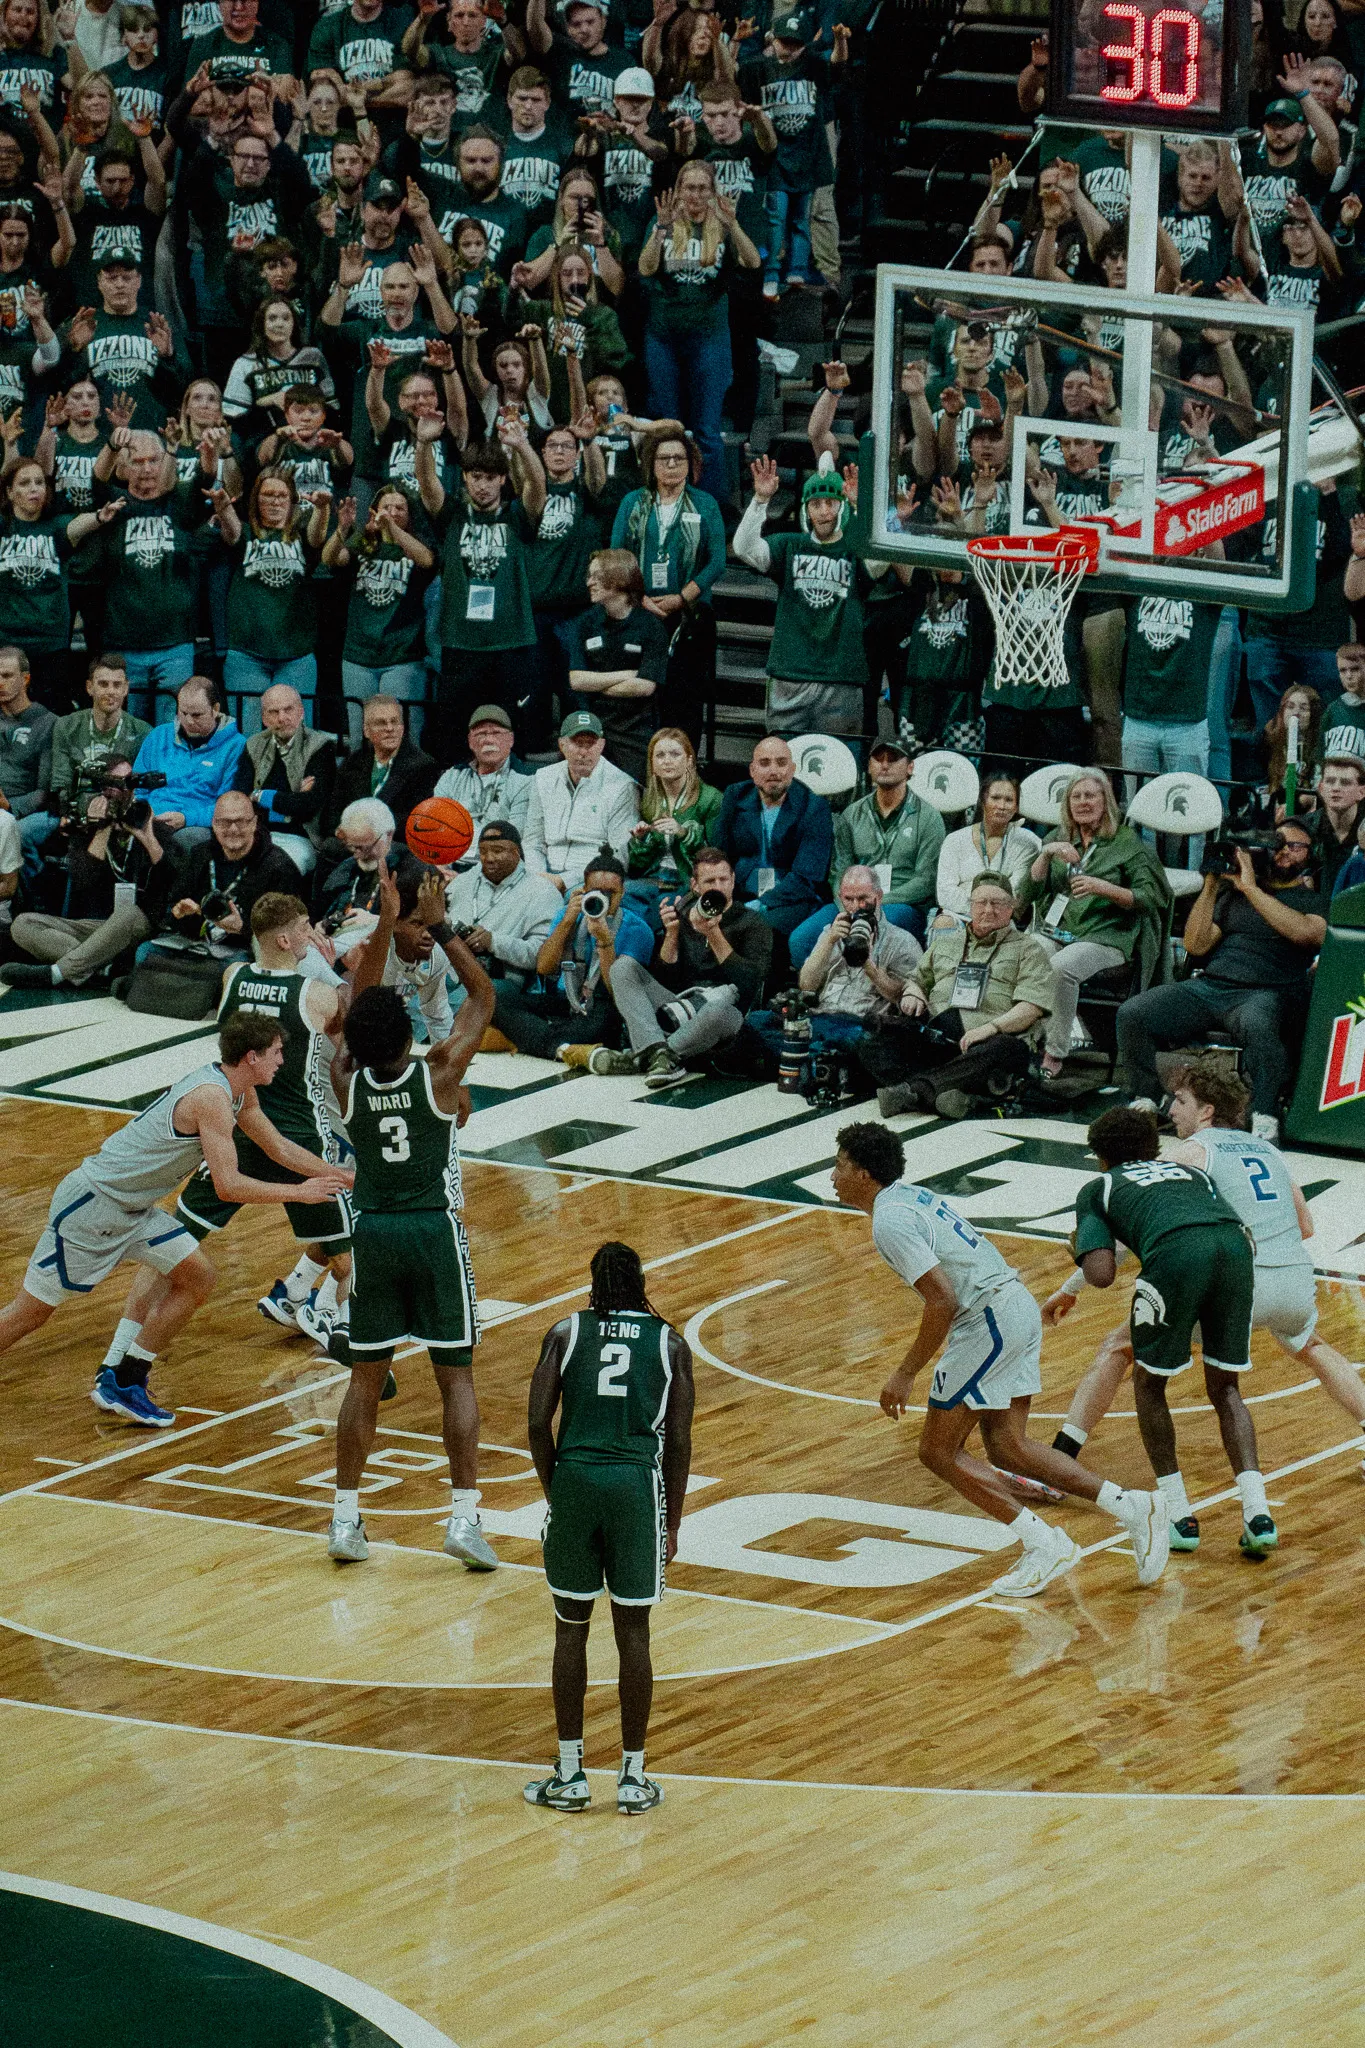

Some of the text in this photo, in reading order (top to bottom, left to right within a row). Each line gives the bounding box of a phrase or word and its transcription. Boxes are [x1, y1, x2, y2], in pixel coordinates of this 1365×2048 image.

[1102, 3, 1199, 109] 30
[87, 334, 159, 368] IZZONE
[792, 554, 851, 585] IZZONE
[1137, 595, 1193, 629] IZZONE
[578, 714, 591, 726] S
[238, 980, 289, 1003] COOPER
[367, 1091, 411, 1113] WARD
[378, 1115, 411, 1164] 3
[1240, 1156, 1279, 1202] 2
[597, 1342, 631, 1397] 2
